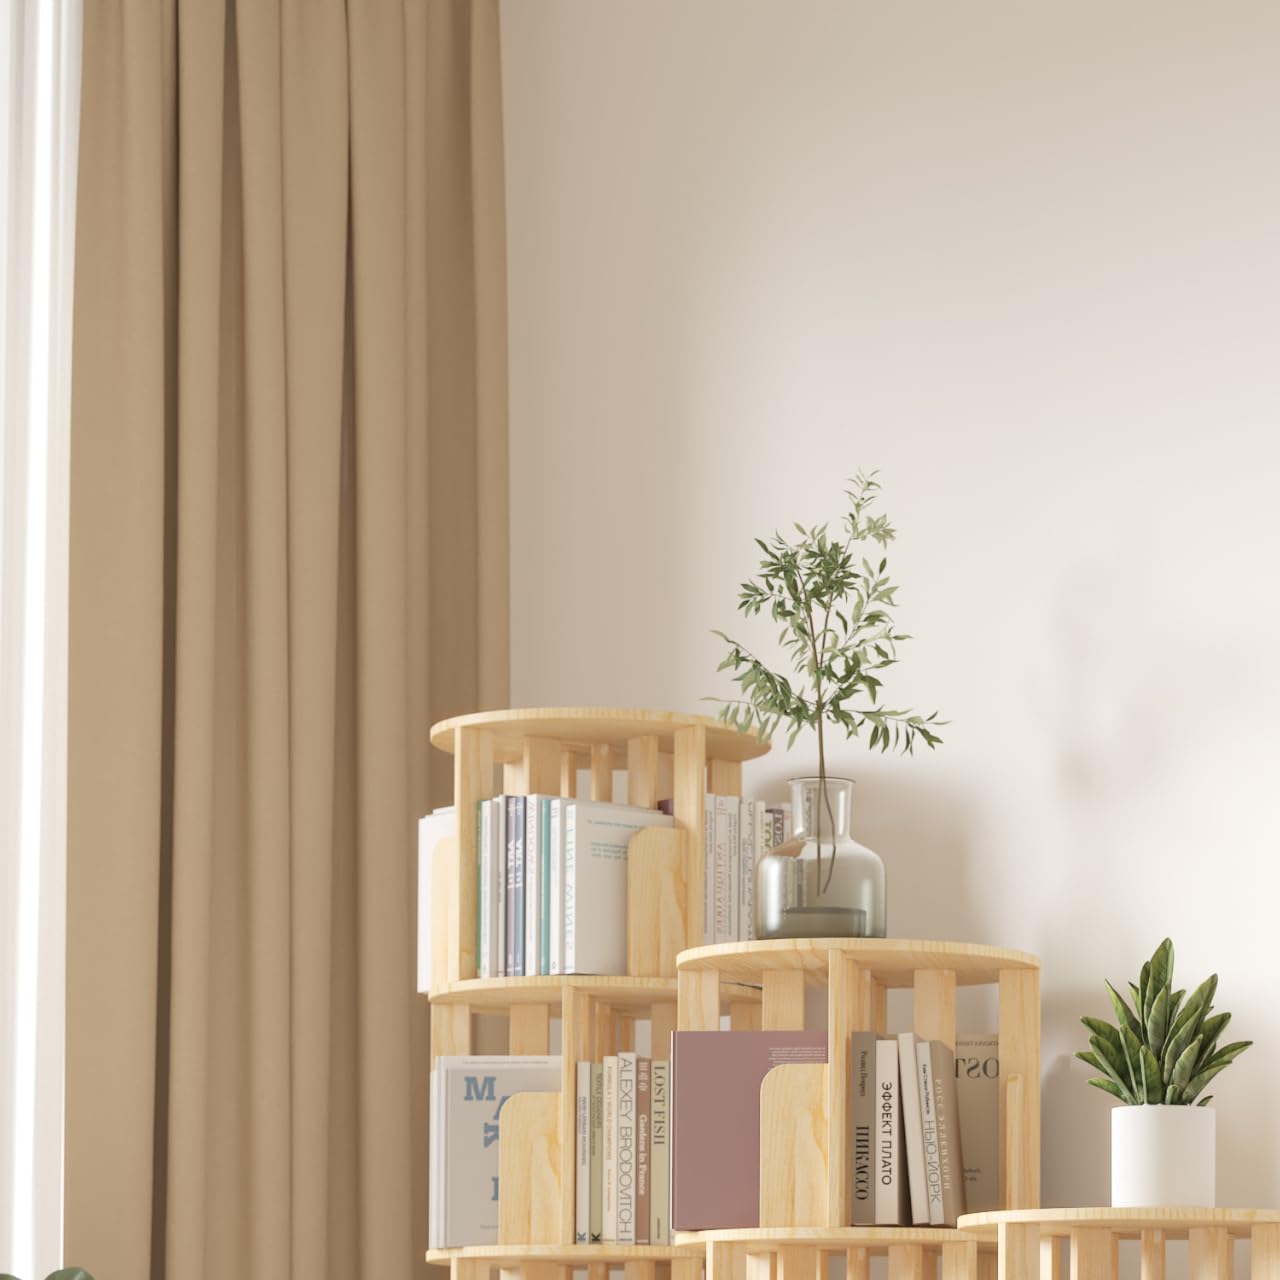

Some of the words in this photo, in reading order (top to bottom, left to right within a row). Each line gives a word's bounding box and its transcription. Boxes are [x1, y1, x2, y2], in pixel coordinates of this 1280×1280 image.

[620, 1057, 633, 1120] ALEXEY
[654, 1066, 665, 1105] LOST
[881, 1082, 892, 1136] ЭФФЕКТ
[654, 1110, 665, 1145] FISH
[620, 1126, 633, 1234] BRODOVITCH
[639, 1165, 647, 1195] France
[856, 1126, 870, 1200] ПИКАССО
[881, 1140, 892, 1185] ПЛАТО
[924, 1120, 941, 1204] НЬЮ-ЙОРК
